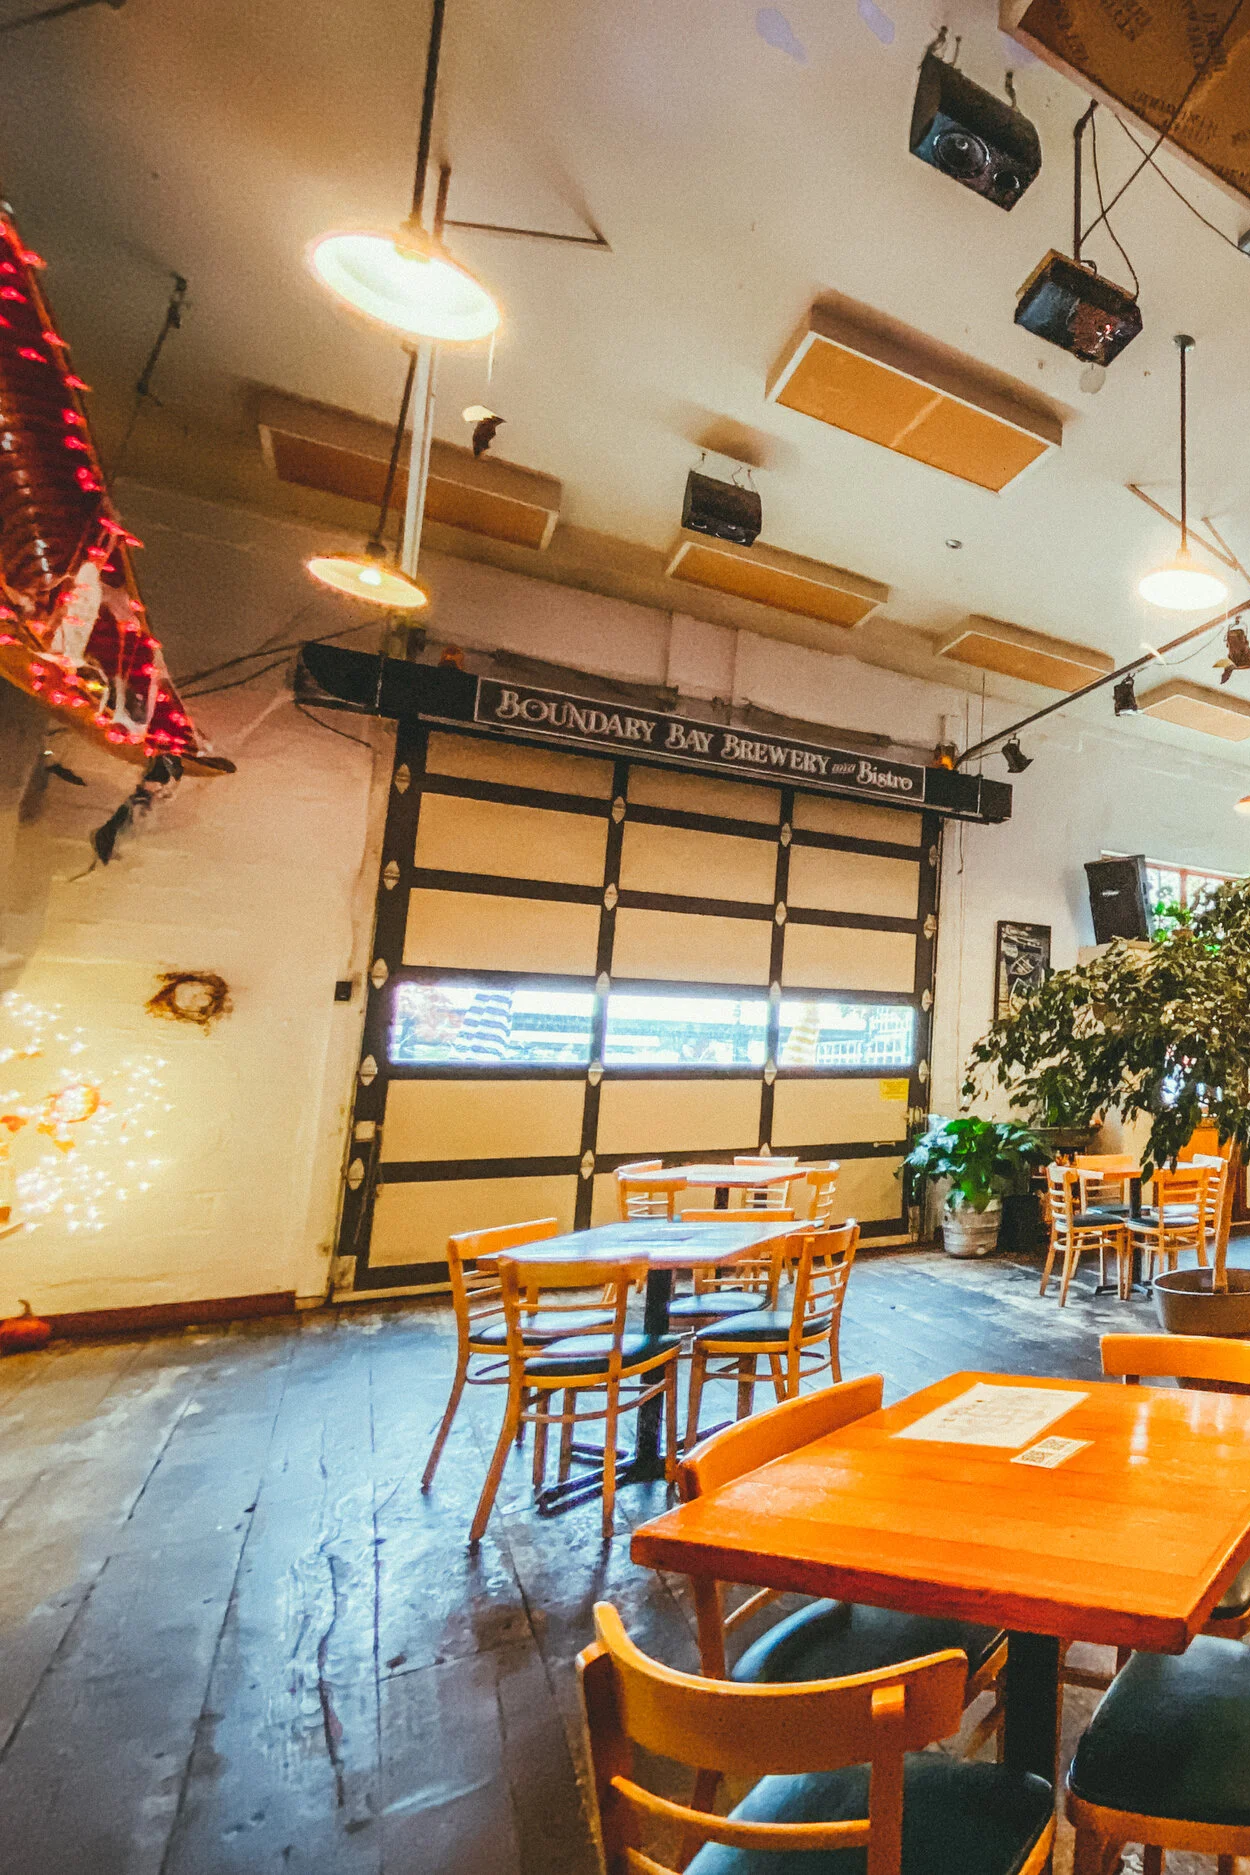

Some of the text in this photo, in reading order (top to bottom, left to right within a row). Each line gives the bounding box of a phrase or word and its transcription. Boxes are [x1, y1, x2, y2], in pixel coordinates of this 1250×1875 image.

[496, 689, 656, 743] BOUNDARY
[665, 722, 714, 754] BAY
[720, 733, 831, 775] BREWERY
[856, 761, 913, 791] Bistro
